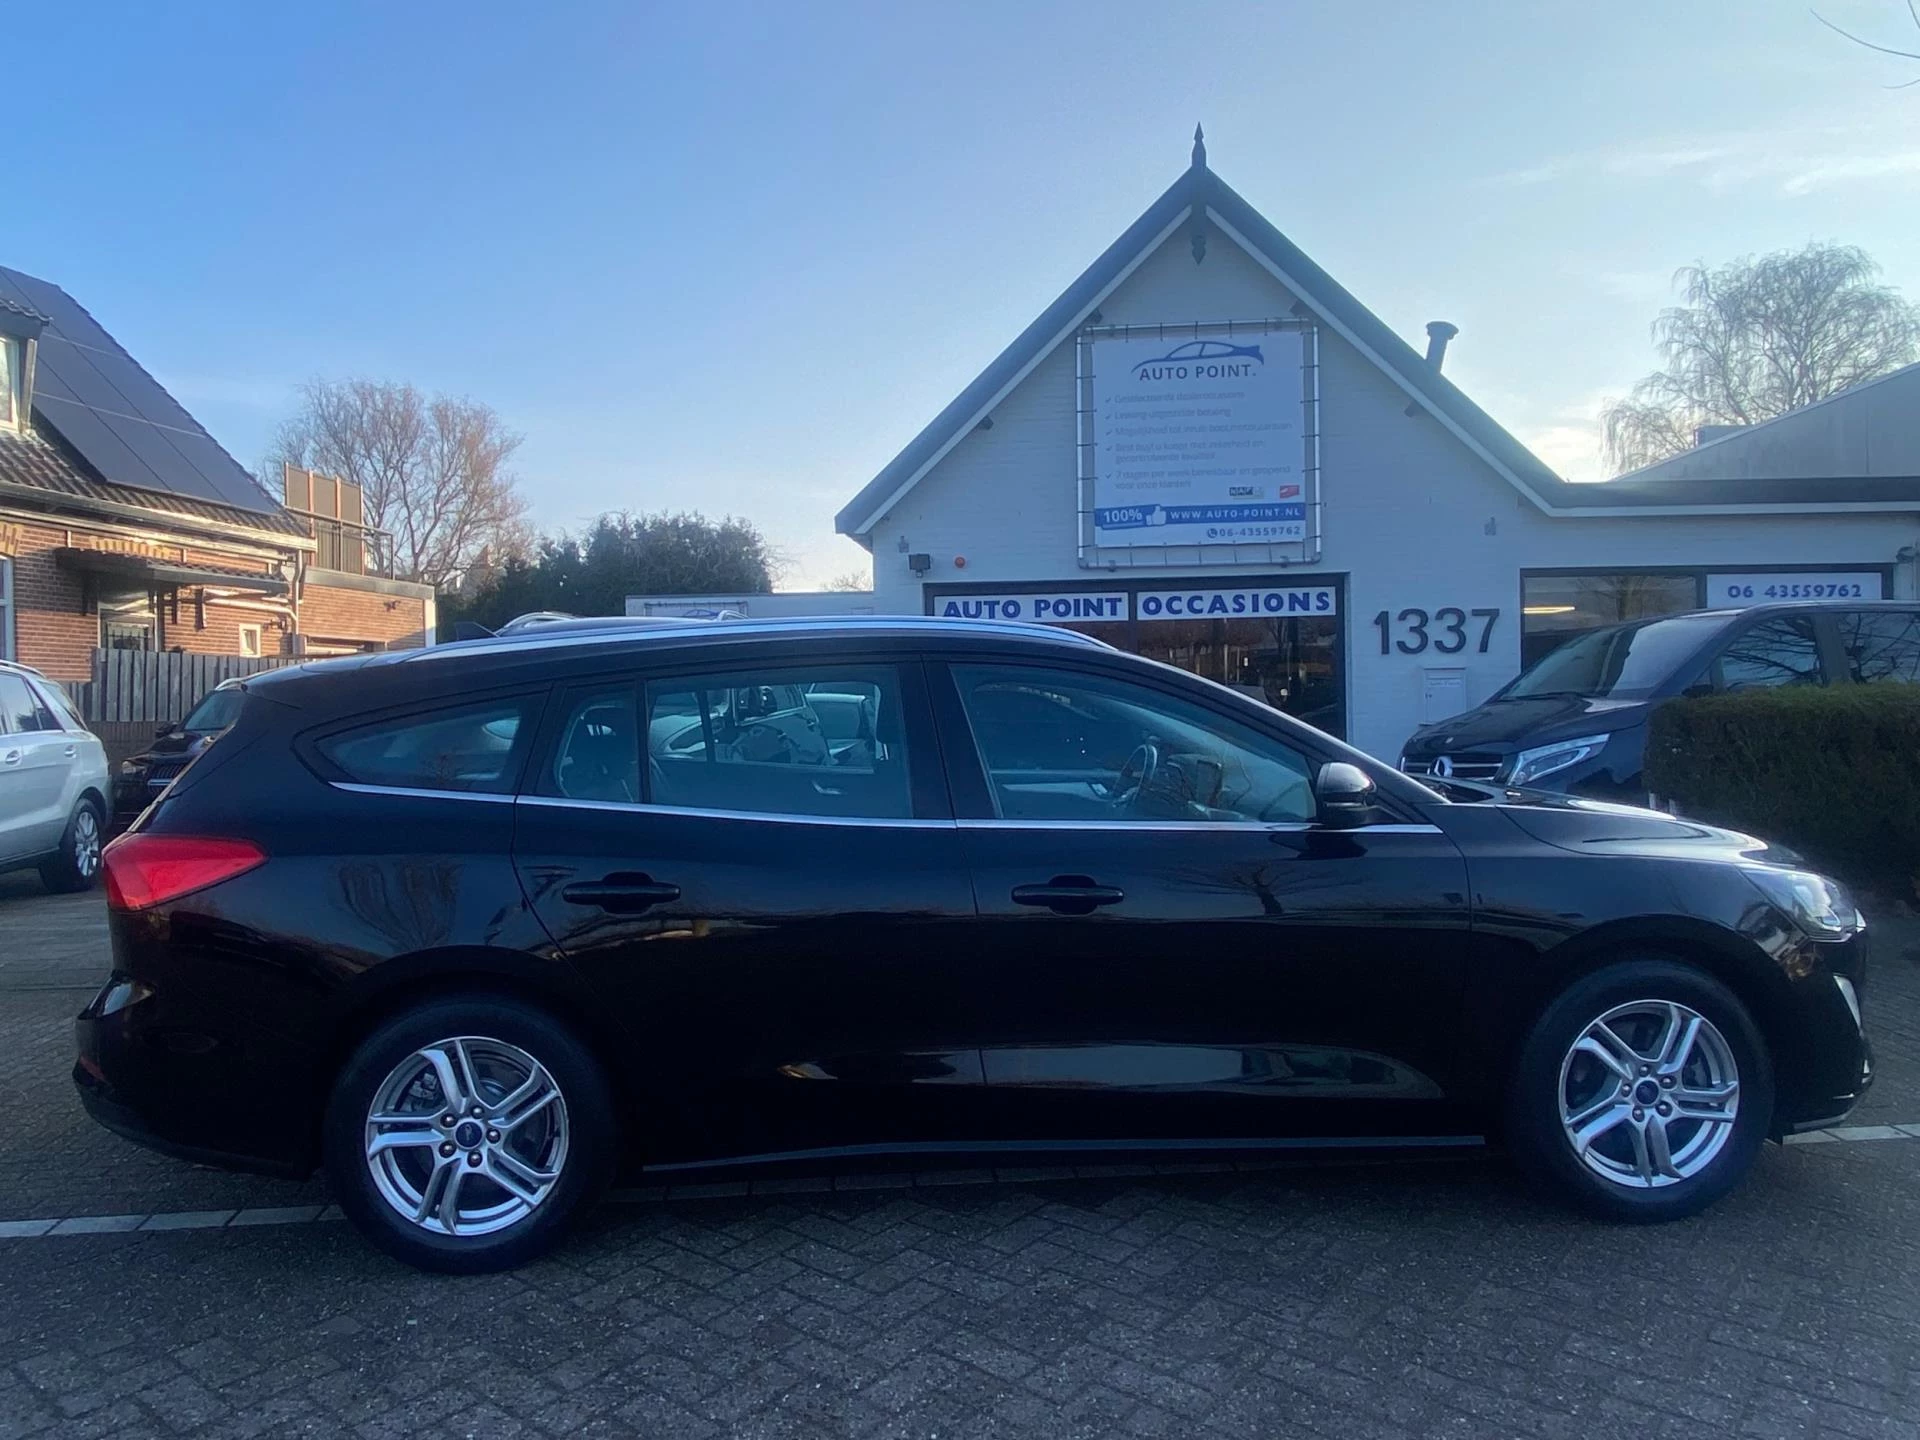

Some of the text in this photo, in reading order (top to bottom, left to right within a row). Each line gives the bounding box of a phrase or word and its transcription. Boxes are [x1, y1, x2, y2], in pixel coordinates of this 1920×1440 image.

[1140, 367, 1188, 381] AUTO
[1104, 509, 1143, 523] 100%
[1728, 584, 1862, 598] 06 43559762
[943, 592, 1330, 619] AUTO POINT OCCASIONS
[1374, 607, 1500, 655] 1337
